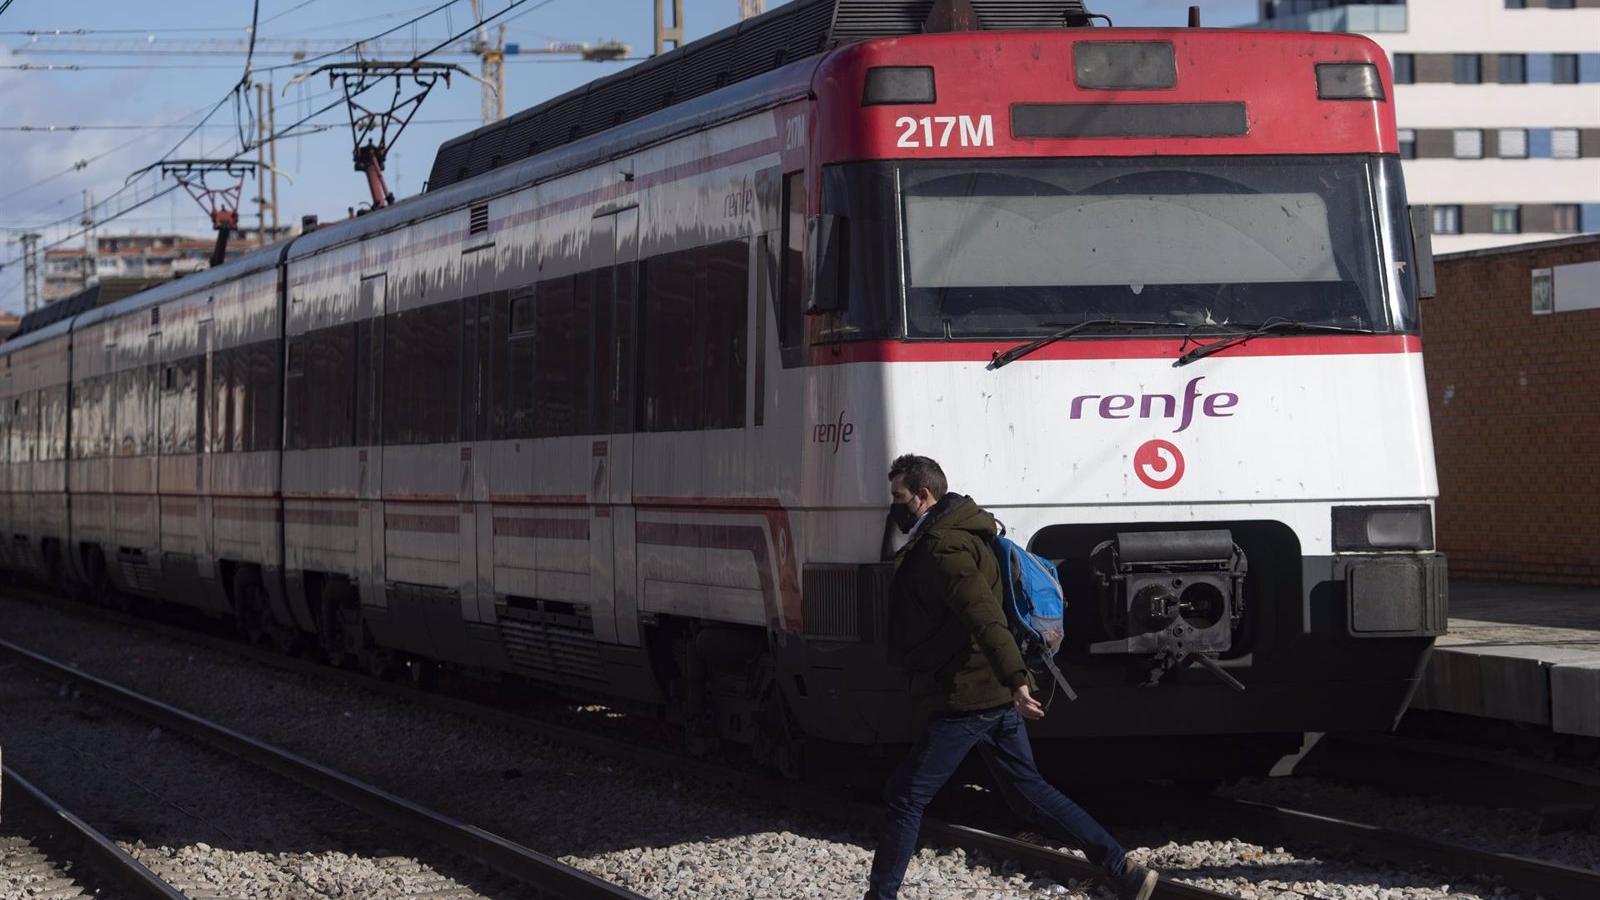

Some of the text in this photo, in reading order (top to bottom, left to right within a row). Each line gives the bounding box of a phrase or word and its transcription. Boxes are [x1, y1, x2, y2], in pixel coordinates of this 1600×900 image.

[895, 114, 995, 148] 217M
[1069, 376, 1240, 433] renfe
[813, 410, 854, 455] renfe
